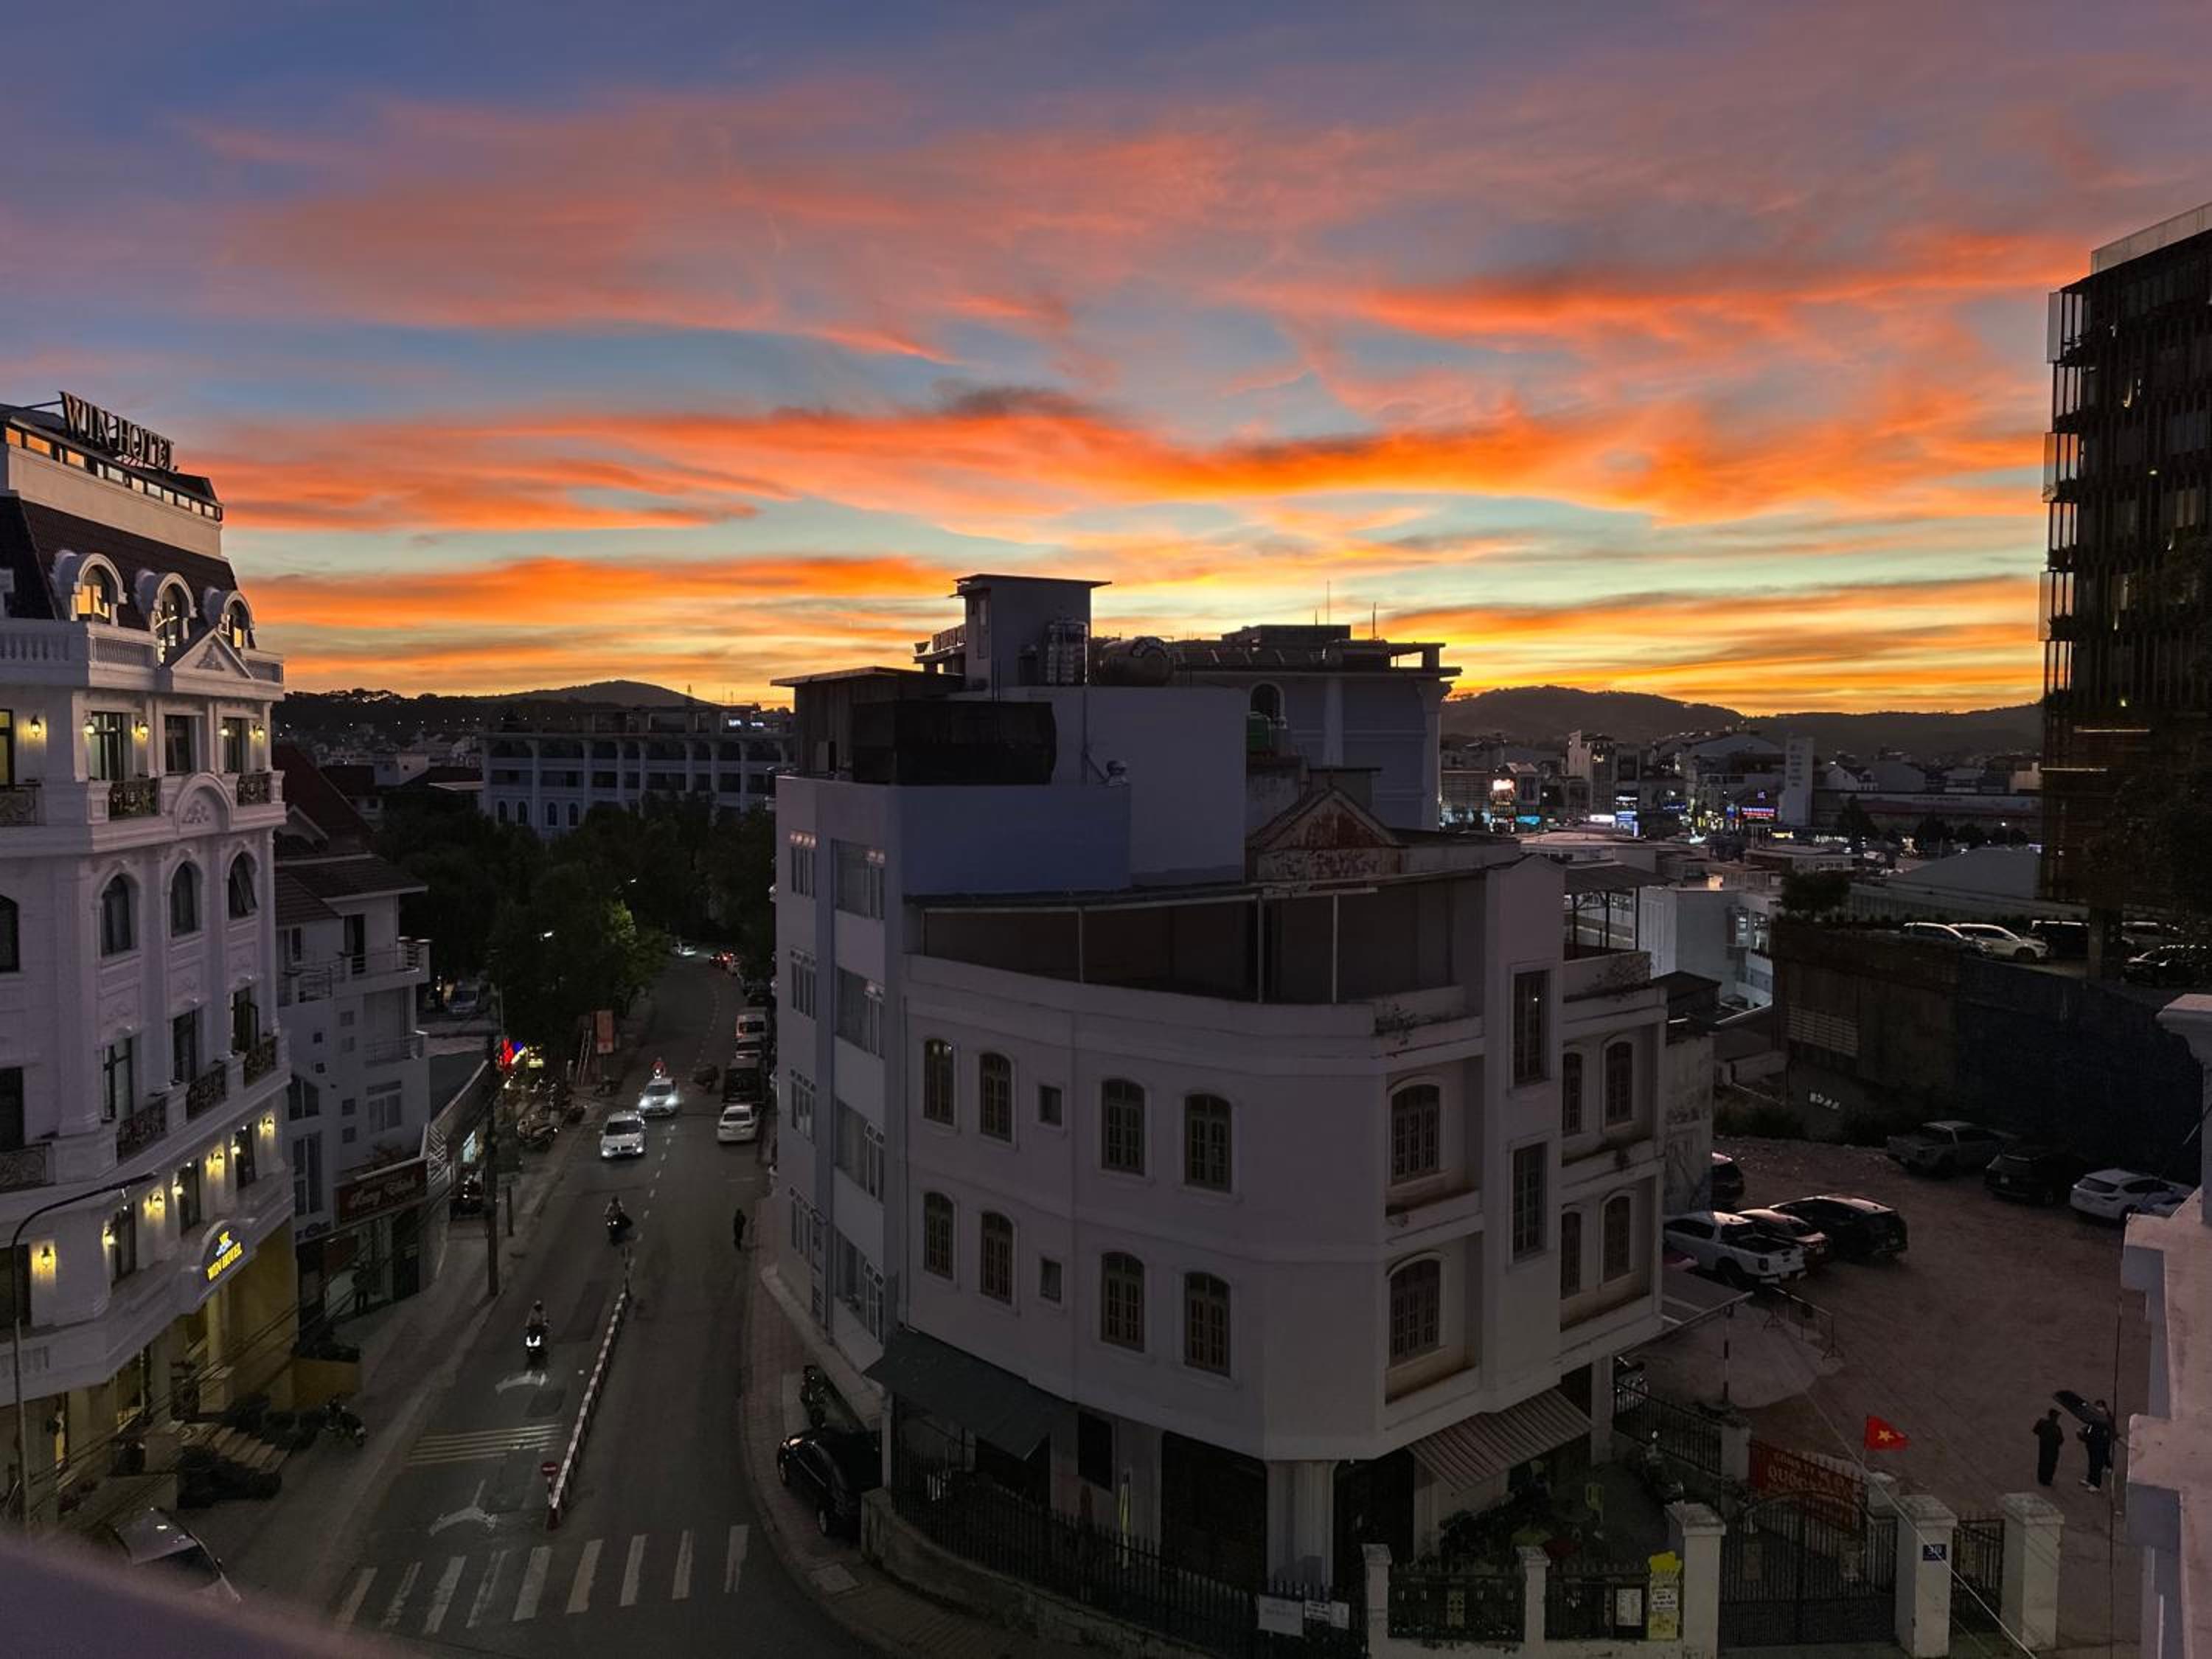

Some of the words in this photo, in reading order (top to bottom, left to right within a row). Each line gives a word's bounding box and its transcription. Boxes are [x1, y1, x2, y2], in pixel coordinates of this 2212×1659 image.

[60, 392, 111, 448] WIN
[117, 415, 175, 472] HOTEL
[207, 1259, 222, 1281] WIN
[222, 1241, 243, 1269] HOTEL
